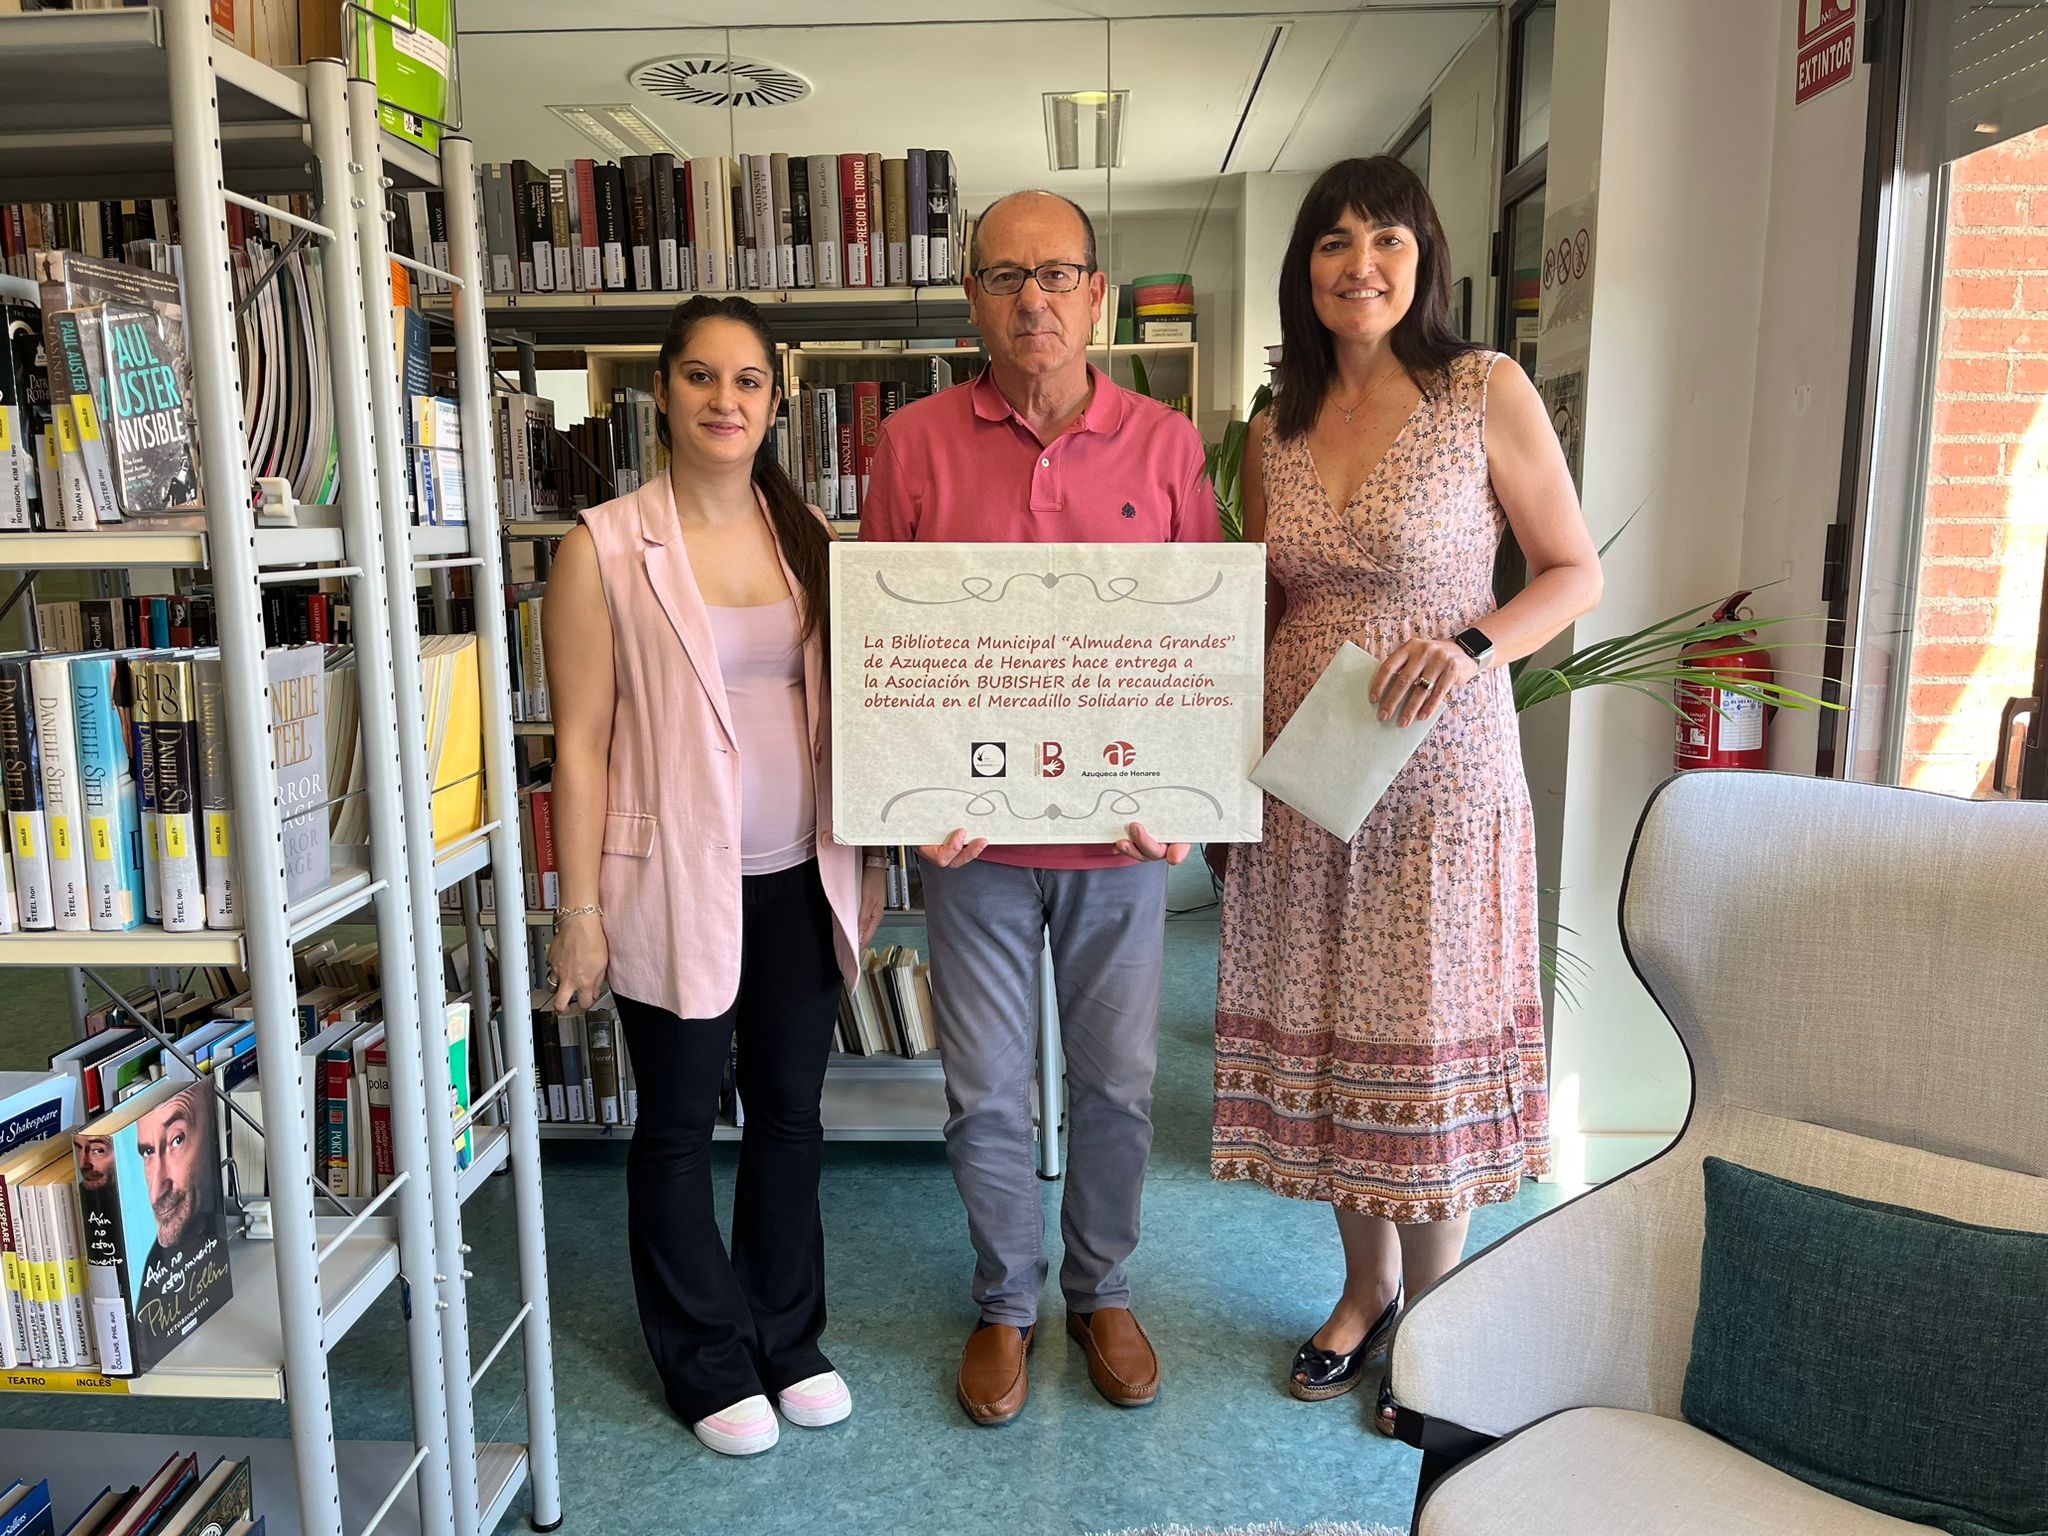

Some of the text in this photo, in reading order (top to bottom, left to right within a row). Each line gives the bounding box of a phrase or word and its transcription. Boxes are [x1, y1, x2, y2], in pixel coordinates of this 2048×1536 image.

[1799, 36, 1852, 92] EXTINTOR
[753, 170, 763, 217] DESNUDO
[819, 190, 830, 209] Juan
[853, 161, 868, 243] PRECIO DEL TRONO
[607, 222, 615, 241] ISABEL
[635, 206, 645, 230] Isabel
[508, 296, 516, 307] H
[60, 321, 88, 392] PAUL AUSTER
[29, 374, 49, 390] PATR
[120, 407, 186, 455] NVISIBLE
[862, 396, 879, 448] MAO
[12, 468, 20, 481] KIM
[97, 468, 113, 511] AUSTER inv
[13, 482, 23, 524] ROBINSON,
[73, 478, 85, 521] ROWAN cha
[501, 525, 512, 535] K
[90, 616, 102, 649] Churchill
[313, 602, 321, 632] MORTON
[864, 636, 883, 649] La
[891, 635, 970, 650] Biblioteca
[977, 635, 1056, 653] Municipal
[864, 655, 1193, 672] de Azuqueca de Henares hace entrega a
[864, 673, 1215, 689] la Asociación BUBISHER de la recaudación
[269, 674, 320, 725] NIELLE
[864, 693, 1233, 708] obtenida en el Mercadillo Solidario de Libros.
[0, 678, 26, 804] DANIELLE STEEL
[38, 695, 65, 807] DANIELLE STEEL
[77, 684, 106, 811] DANIELLE STEEL
[273, 720, 313, 770] TEEL
[154, 727, 188, 813] DANIELLE STE
[1081, 770, 1118, 779] Azuqueca
[1130, 770, 1160, 778] Henares
[276, 773, 322, 807] RROR
[283, 800, 316, 832] AGE
[29, 886, 38, 923] STEEL hon
[67, 882, 77, 918] STEEL hrh
[103, 884, 113, 919] STEEL sis
[176, 888, 186, 924] STEEL lon
[224, 880, 233, 915] STEEL mir
[368, 1078, 390, 1091] pola
[6, 1109, 59, 1143] Shakespeare
[330, 1130, 343, 1164] PORTU
[88, 1211, 112, 1227] Aún
[94, 1229, 107, 1237] no
[11, 1217, 25, 1262] SHAKESPEA
[91, 1239, 116, 1256] estoy
[88, 1256, 124, 1266] muerto
[144, 1251, 183, 1288] Aún no
[161, 1238, 218, 1295] estoy muerto
[137, 1294, 182, 1337] Phil
[189, 1261, 228, 1302] Collins
[15, 1305, 28, 1354] SHAKESPEARE
[38, 1314, 53, 1362] SHAKESPEARE
[56, 1317, 70, 1366] SHAKESPEARE
[75, 1311, 88, 1358] SHAKESPEARE
[111, 1326, 119, 1341] PHIL
[7, 1376, 112, 1388] TEATRO INGLÉS
